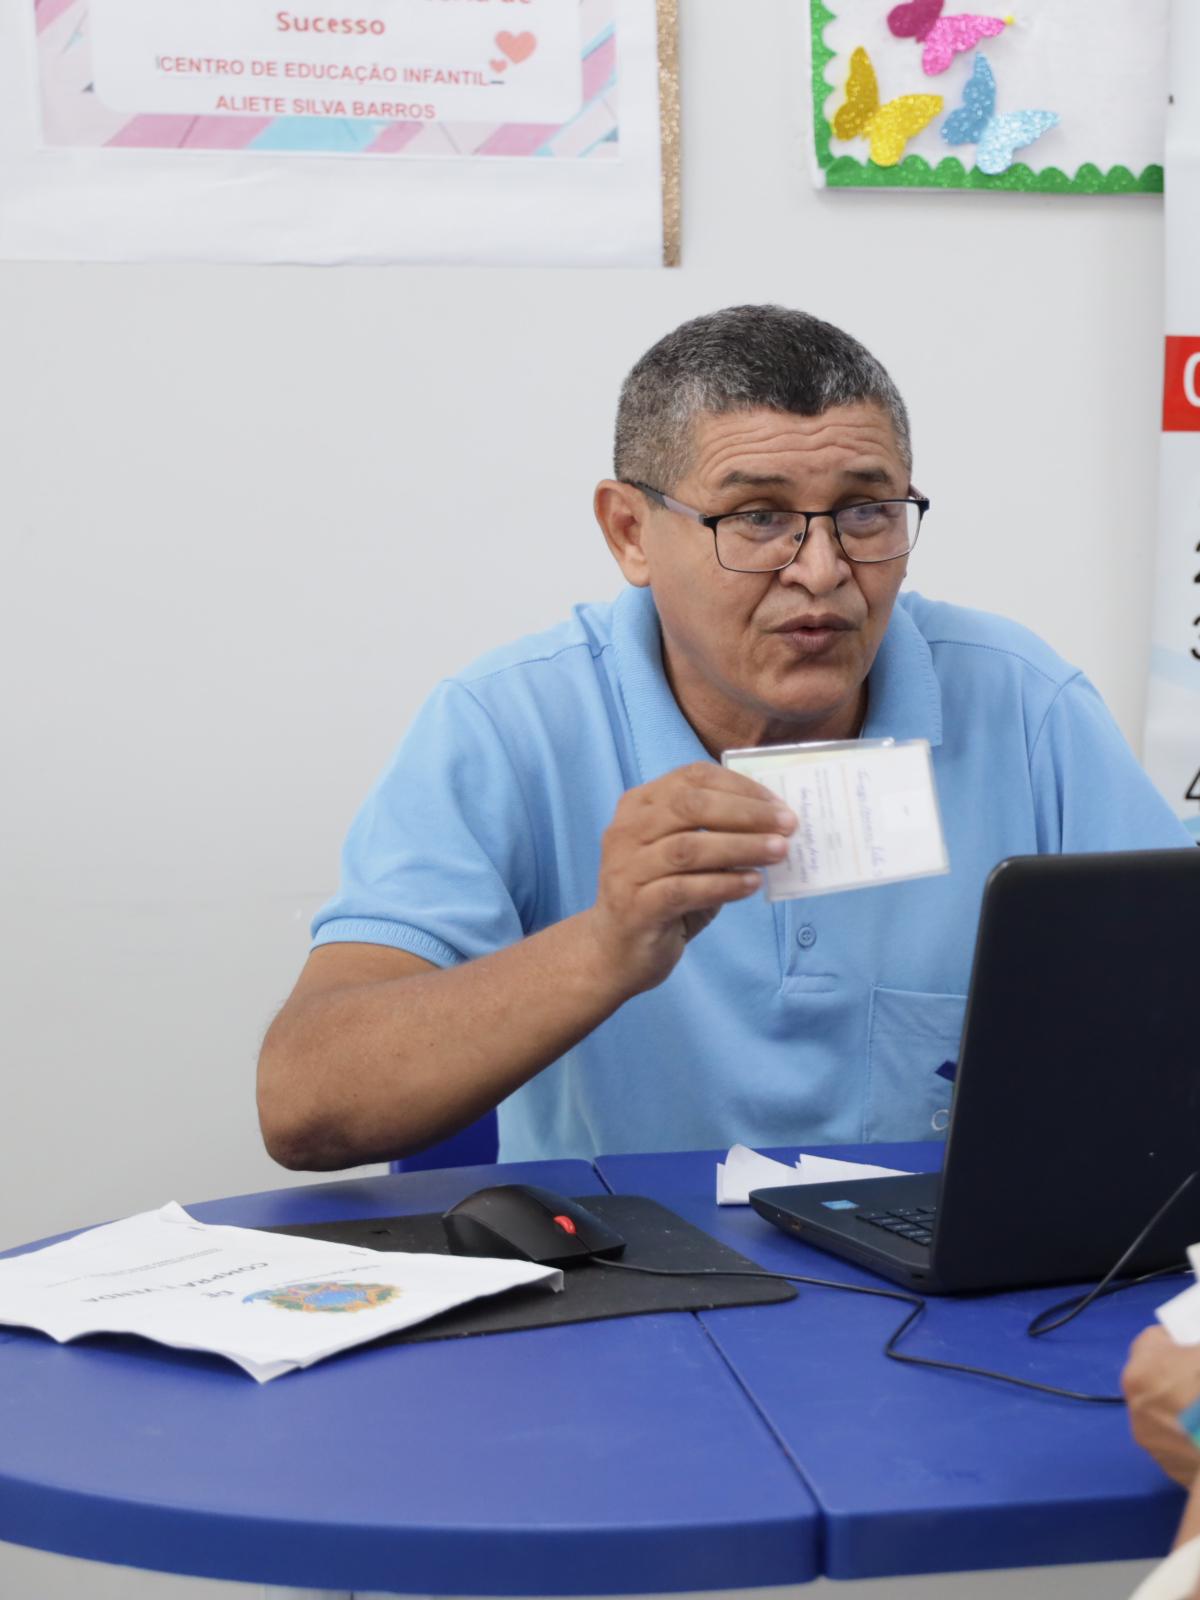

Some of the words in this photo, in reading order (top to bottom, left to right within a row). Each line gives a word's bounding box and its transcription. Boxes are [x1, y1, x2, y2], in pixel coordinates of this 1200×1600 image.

[276, 11, 386, 36] Sucesso
[251, 60, 278, 77] DE
[284, 62, 397, 84] EDUCAÇÃO
[215, 96, 286, 113] ALIETE
[292, 98, 346, 115] SILVA
[352, 101, 436, 119] BARROS
